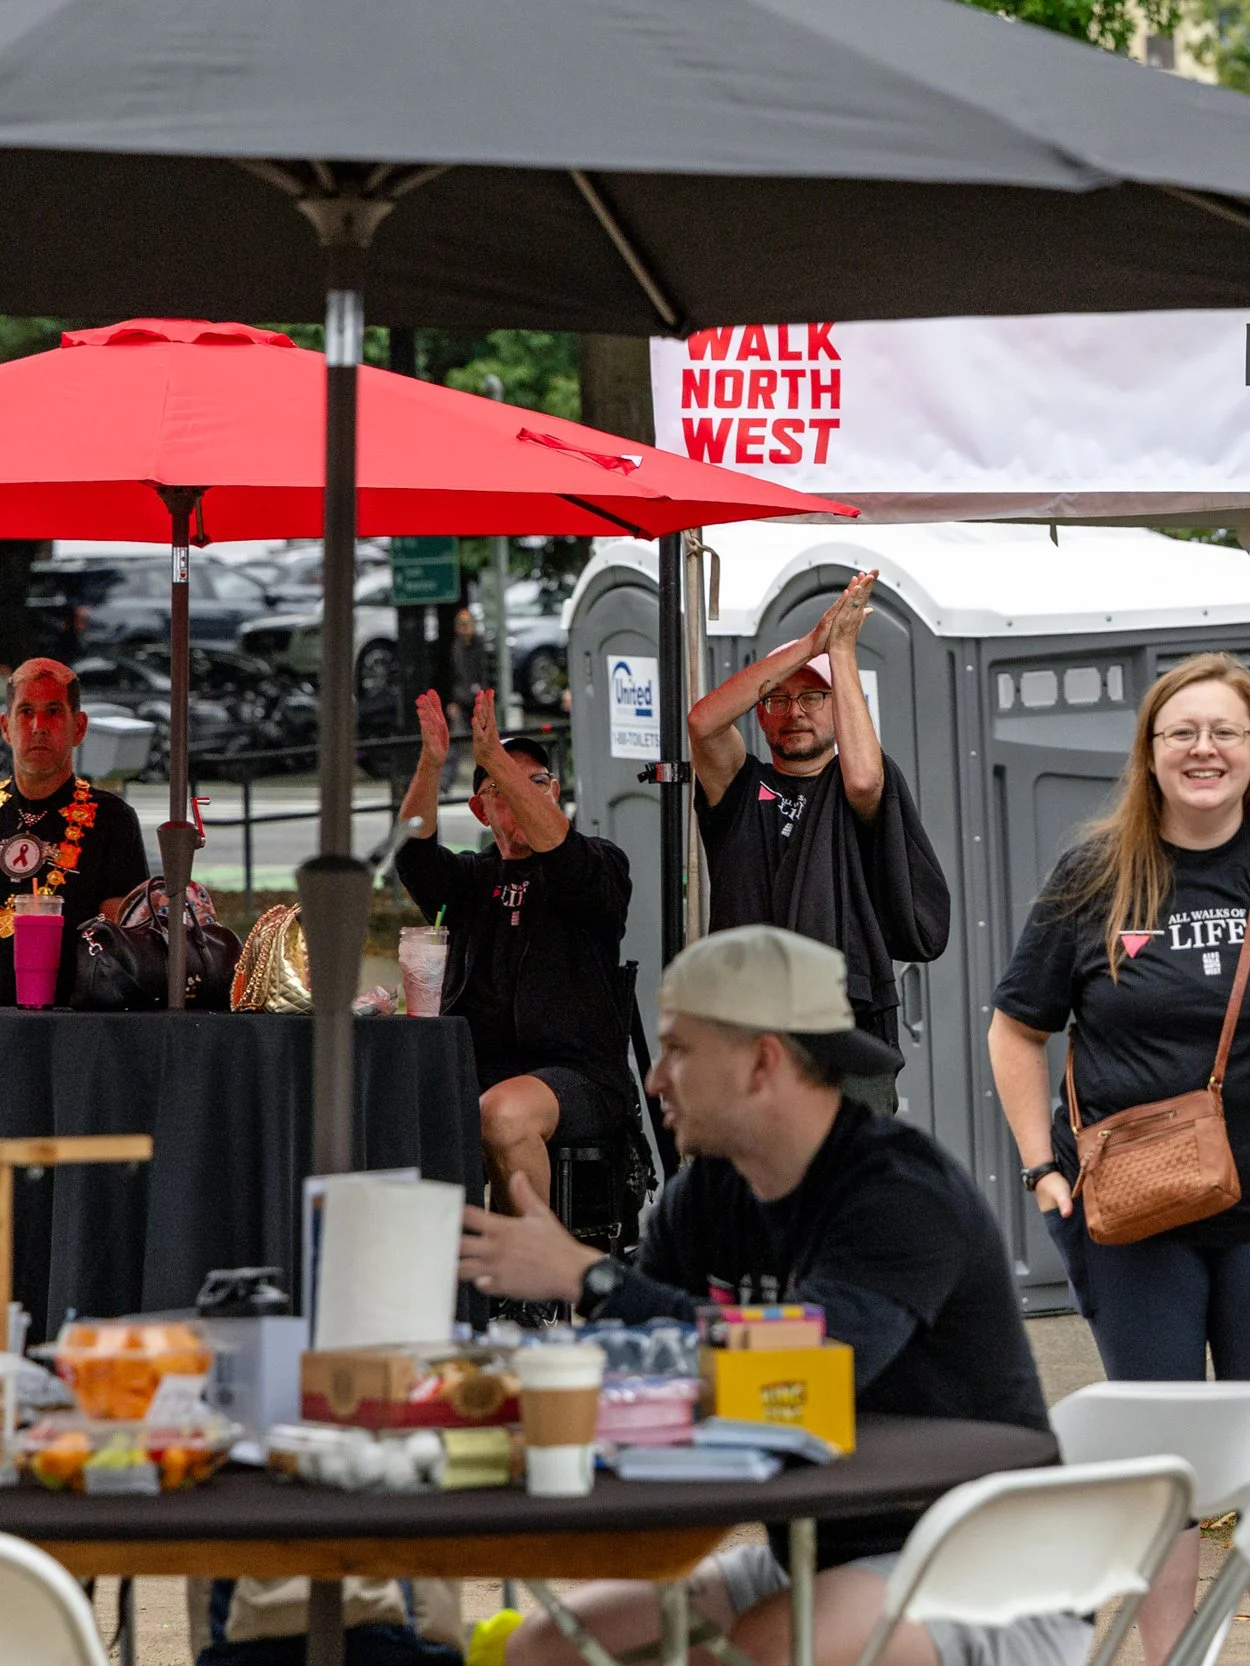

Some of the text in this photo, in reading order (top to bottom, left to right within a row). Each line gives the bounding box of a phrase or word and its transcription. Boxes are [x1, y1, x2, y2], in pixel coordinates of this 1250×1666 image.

[687, 322, 842, 361] WALK
[681, 368, 841, 410] NORTH
[681, 418, 840, 465] WEST
[614, 677, 653, 706] United
[1168, 908, 1247, 925] ALL WALKS OF
[1168, 918, 1247, 950] LIFE
